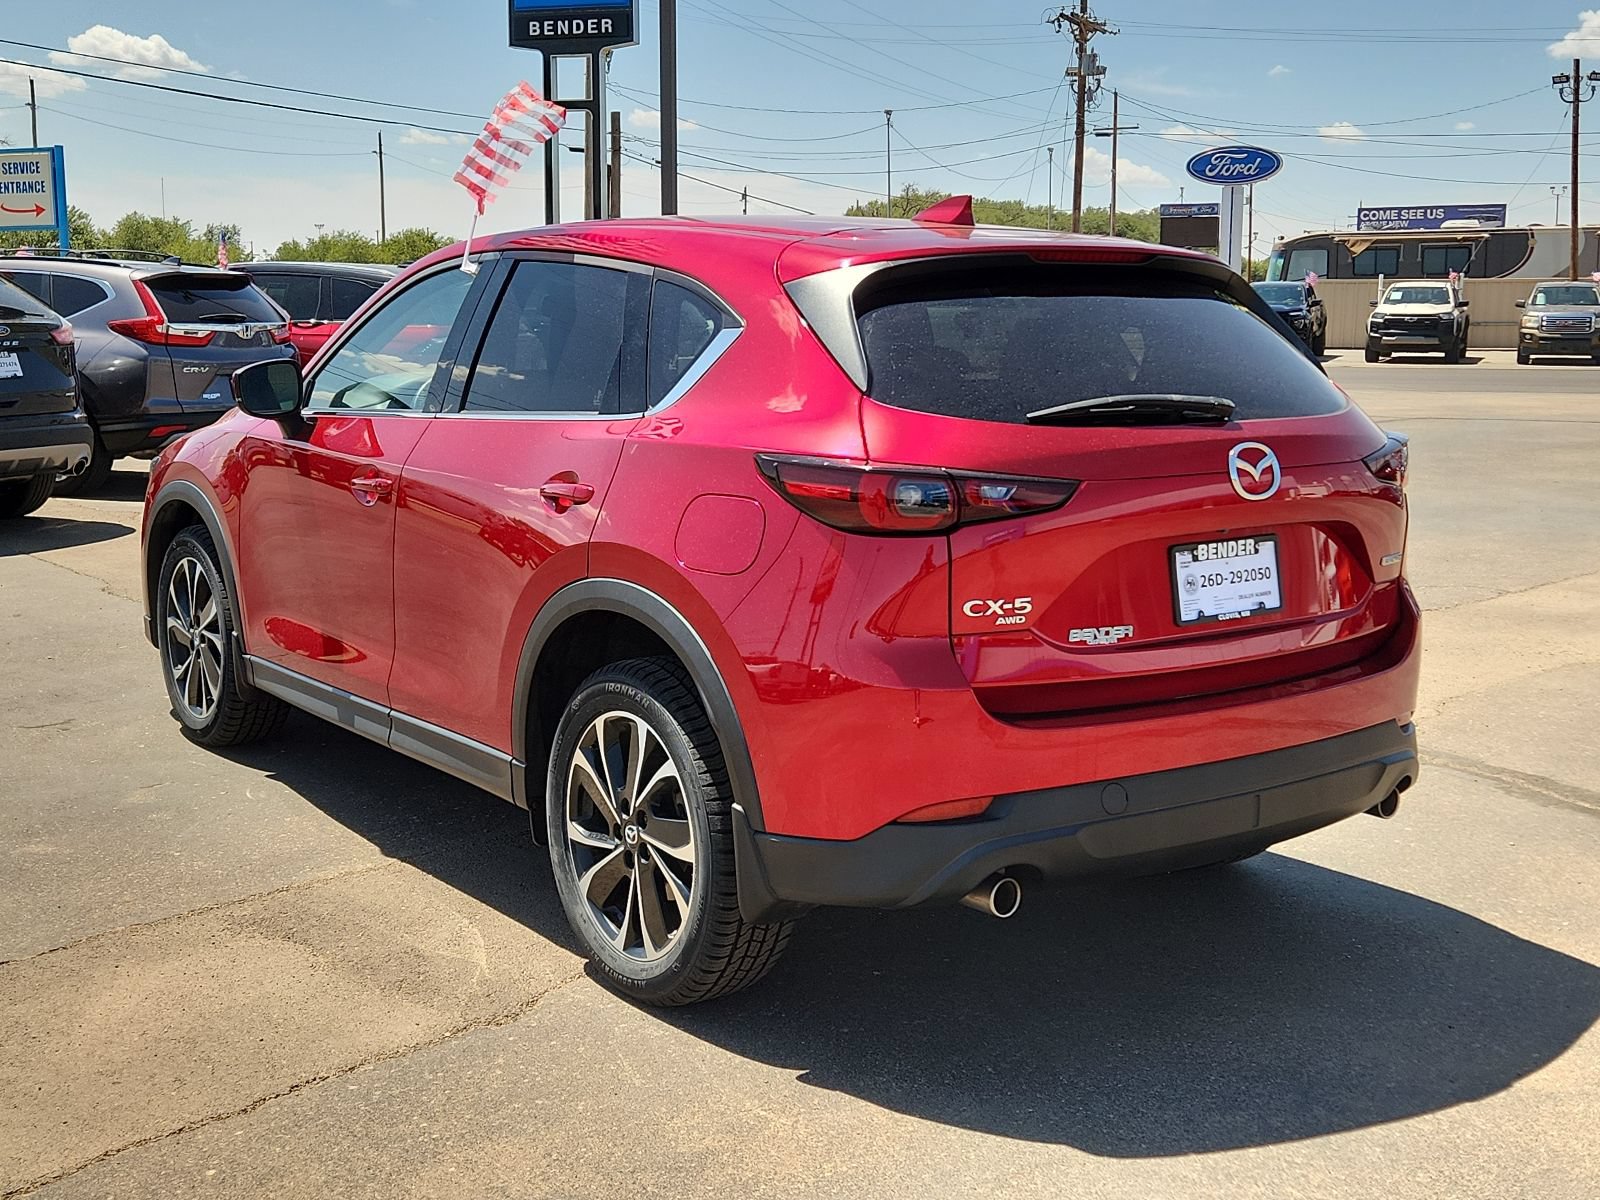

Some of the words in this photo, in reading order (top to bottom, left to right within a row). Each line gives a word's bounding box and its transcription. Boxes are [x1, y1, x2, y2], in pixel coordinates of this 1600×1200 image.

[529, 19, 613, 36] BENDER
[2, 161, 41, 175] SERVICE
[1205, 153, 1262, 177] Ford
[0, 180, 46, 195] ENTRANCE
[1360, 209, 1398, 220] COME
[1400, 209, 1424, 220] SEE
[1426, 208, 1445, 219] US
[1197, 538, 1255, 561] BENDER
[1200, 566, 1271, 588] 26D-292050
[962, 597, 1033, 617] CX-5
[995, 615, 1026, 625] AWD
[1068, 625, 1134, 642] BENDER
[605, 682, 650, 709] IRONMAN
